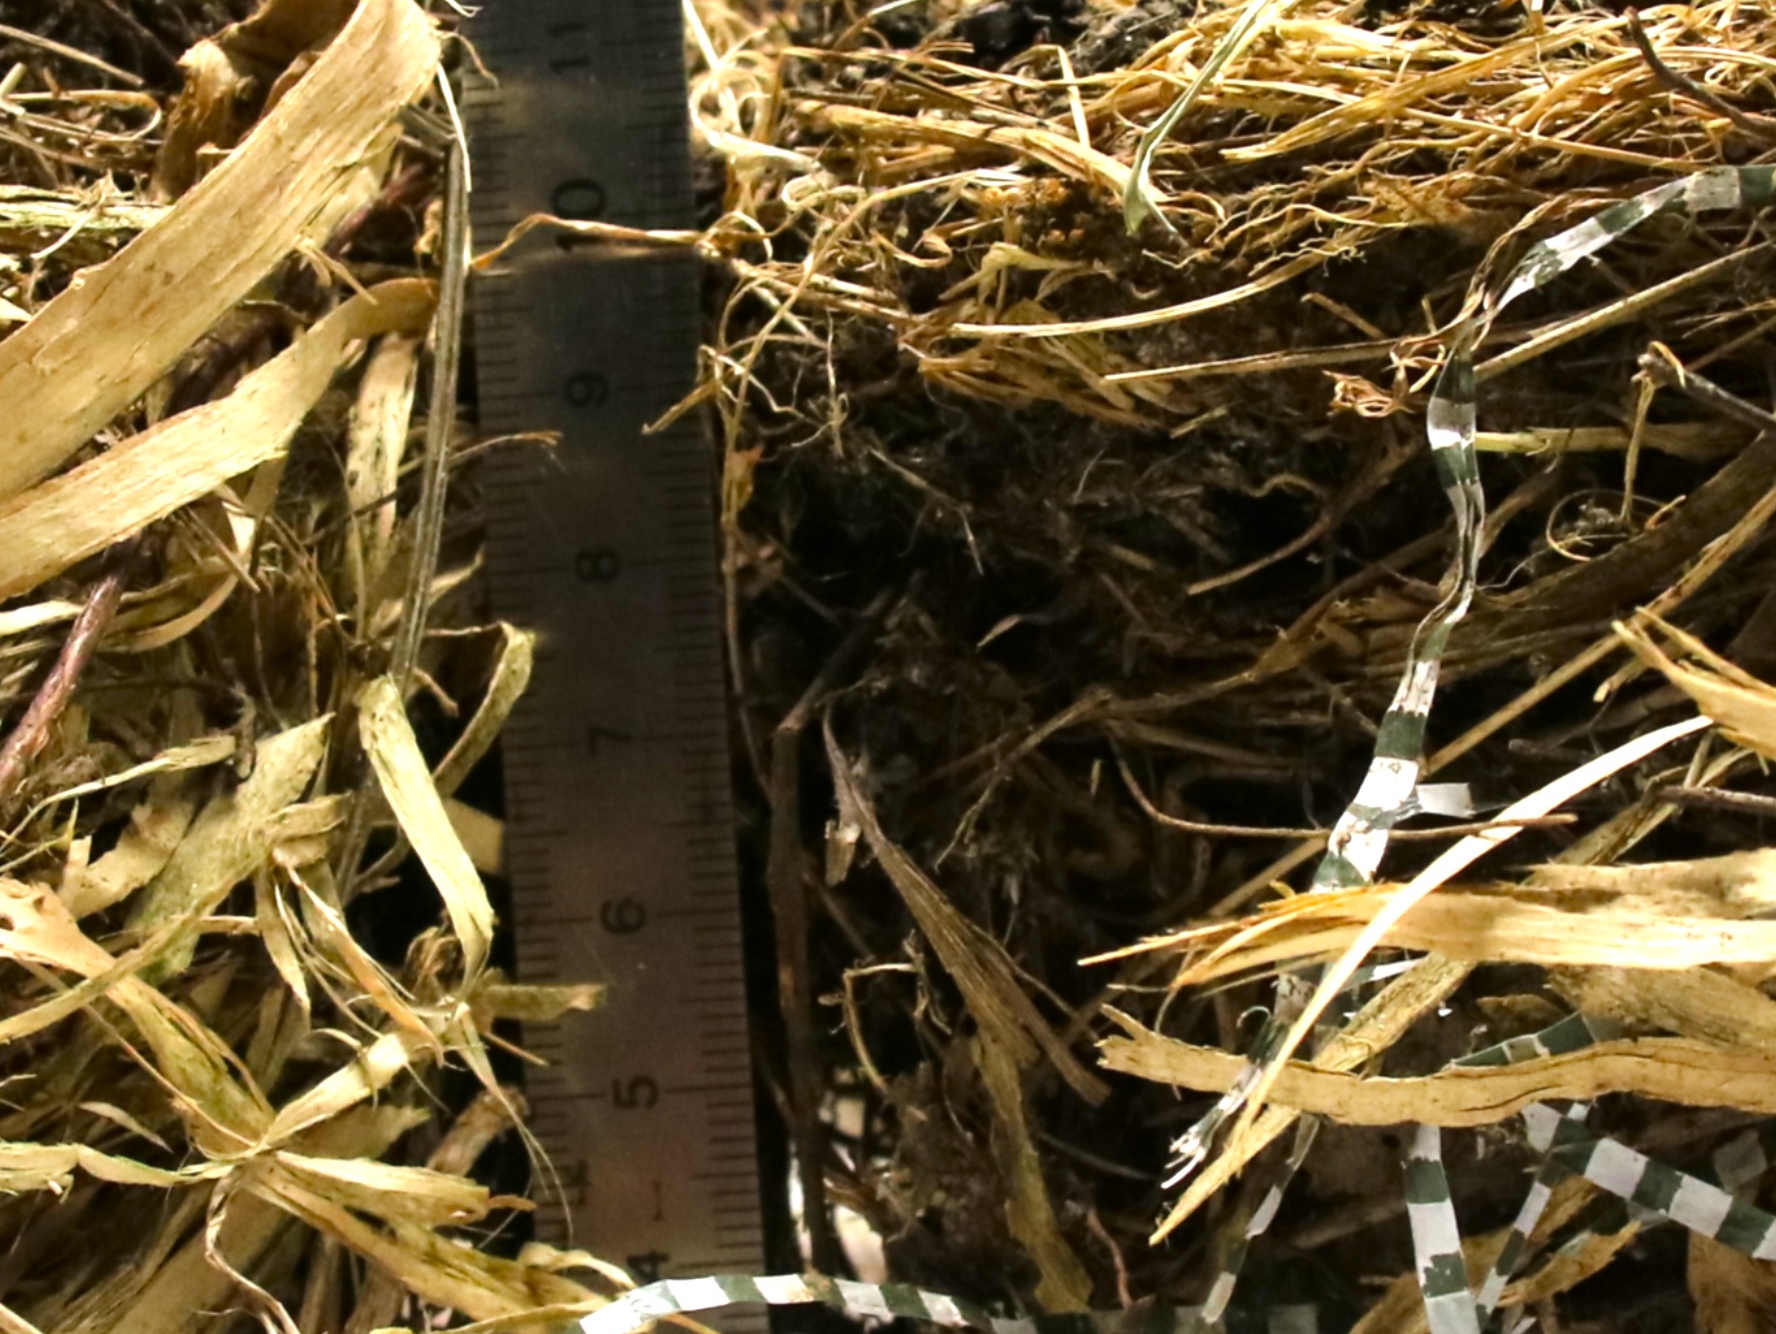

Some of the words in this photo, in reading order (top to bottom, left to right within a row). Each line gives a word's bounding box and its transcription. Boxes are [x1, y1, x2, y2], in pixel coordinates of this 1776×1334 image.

[545, 22, 590, 74] 11
[550, 177, 607, 253] 10
[564, 370, 608, 407] 9
[574, 547, 621, 583] 8
[587, 722, 632, 757] 7
[599, 896, 647, 934] 6
[611, 1073, 659, 1108] 5
[626, 1251, 670, 1287] 4
